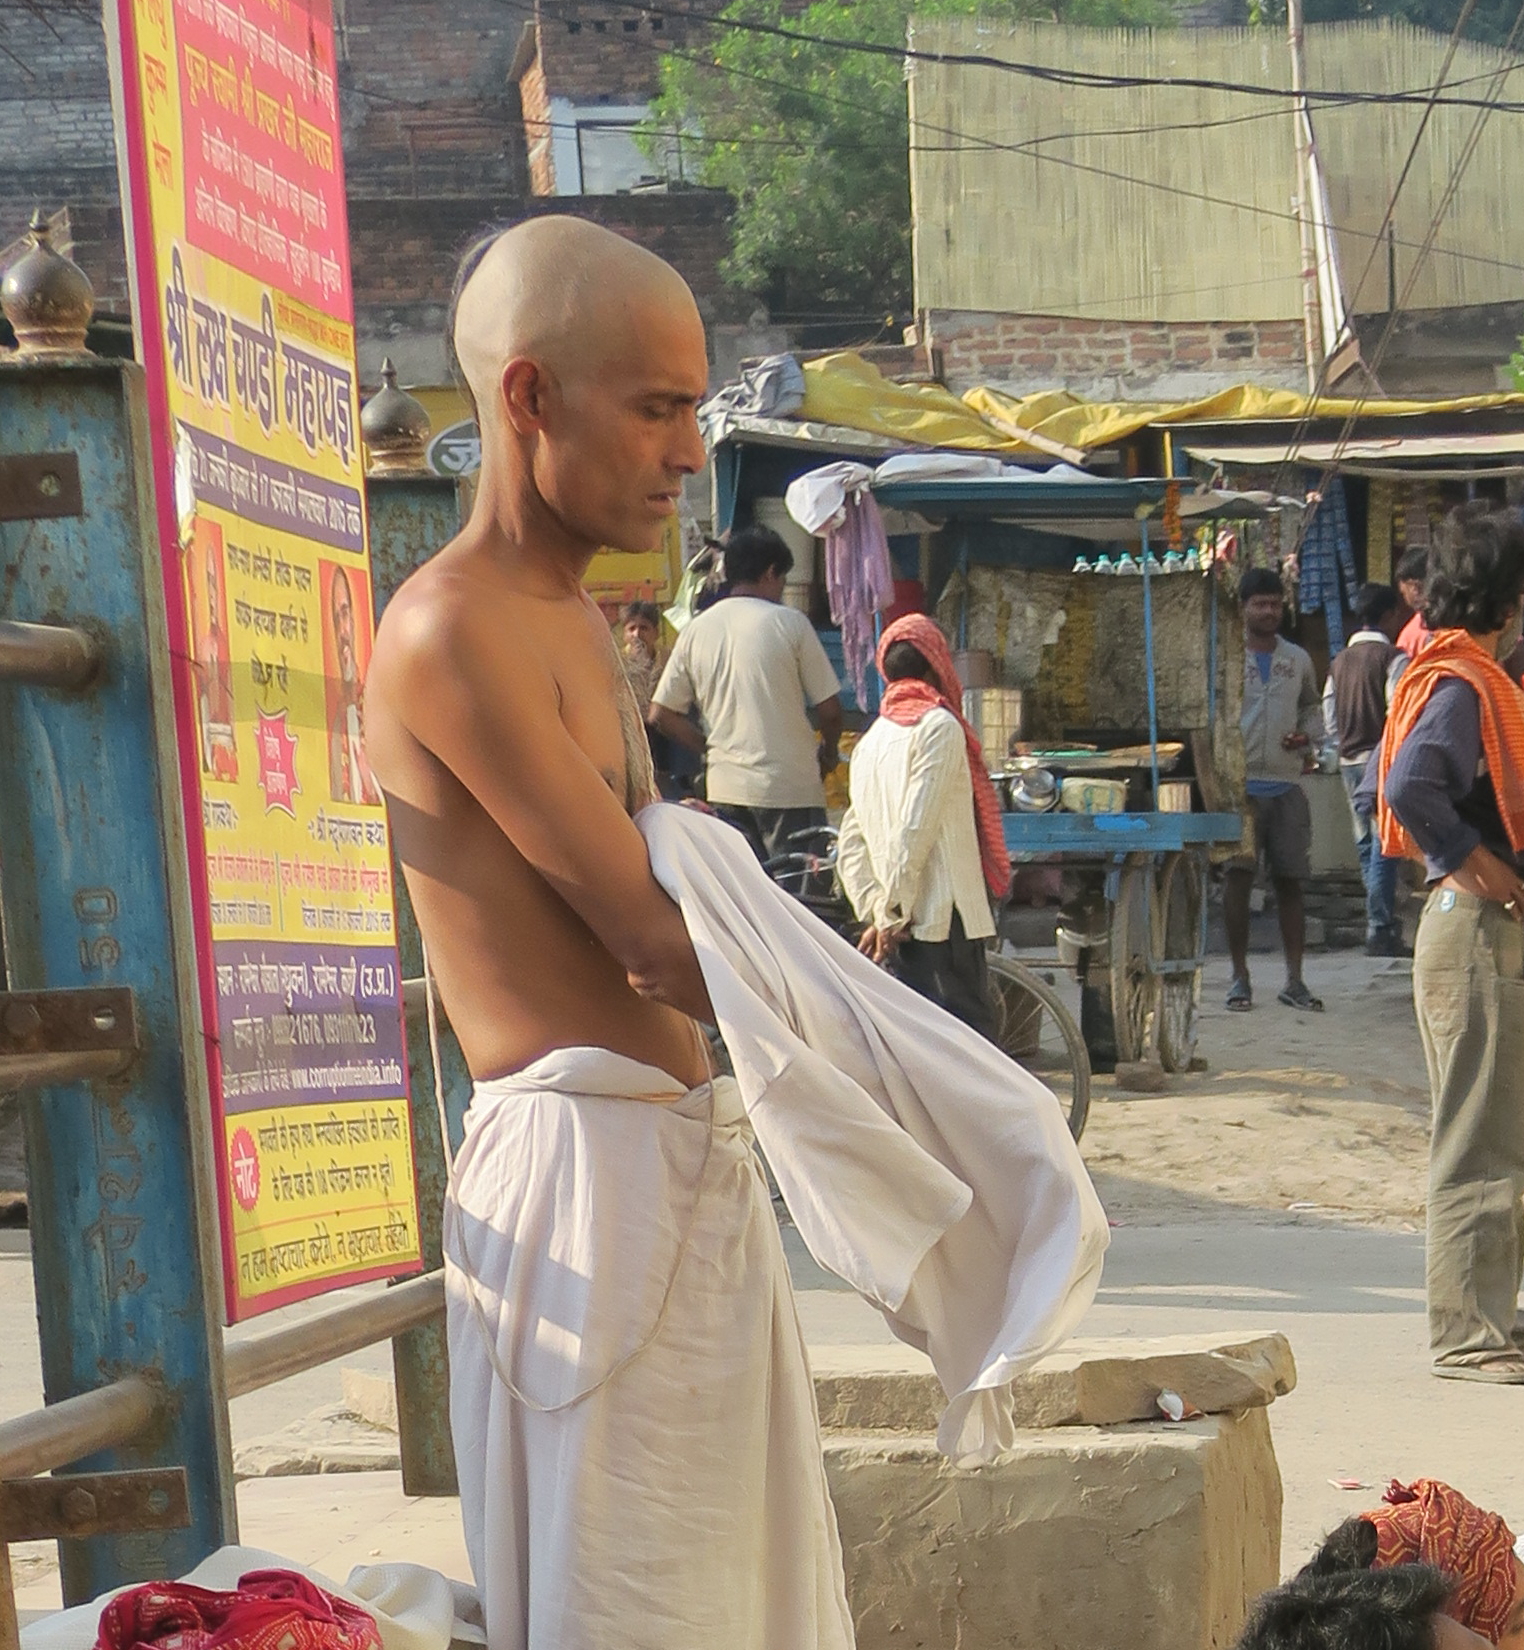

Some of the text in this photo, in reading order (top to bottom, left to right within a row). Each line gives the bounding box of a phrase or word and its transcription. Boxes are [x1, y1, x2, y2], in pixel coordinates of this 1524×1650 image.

[167, 246, 192, 390] श्री
[231, 293, 278, 432] चण्डी
[281, 341, 355, 467] महायज्ञ
[360, 963, 394, 998] (उ.प्र.)
[235, 1143, 257, 1199] नोट
[240, 1254, 251, 1283] न
[251, 1248, 269, 1282] हम
[270, 1239, 309, 1278] भ्रष्टाचार
[336, 1232, 347, 1260] न
[348, 1226, 384, 1263] भ्रष्टाचार
